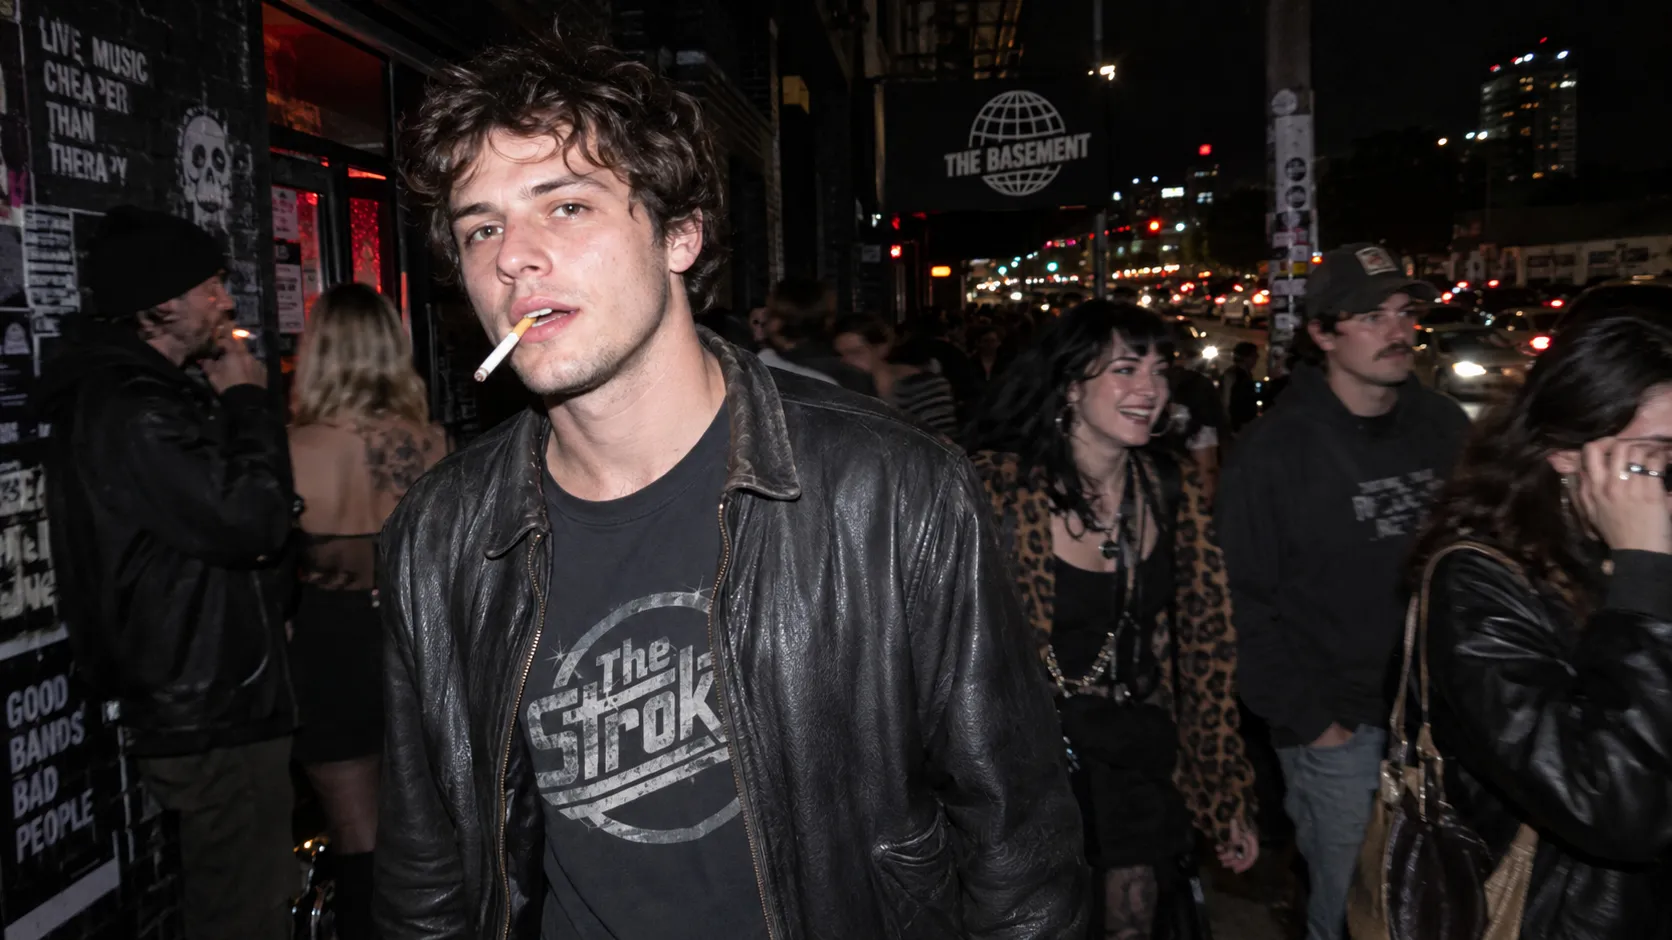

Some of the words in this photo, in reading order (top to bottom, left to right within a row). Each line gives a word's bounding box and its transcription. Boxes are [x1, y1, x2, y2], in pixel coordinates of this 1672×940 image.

[39, 16, 83, 65] LIVE
[93, 36, 148, 83] MUSIC
[46, 101, 95, 142] THAN
[944, 150, 981, 177] THE
[987, 133, 1091, 172] BASEMENT
[596, 636, 670, 694] The
[7, 674, 69, 729] GOOD
[526, 645, 727, 788] Strok
[10, 709, 86, 774] BANDS
[13, 765, 59, 819] BAD
[17, 788, 94, 863] PEOPLE
